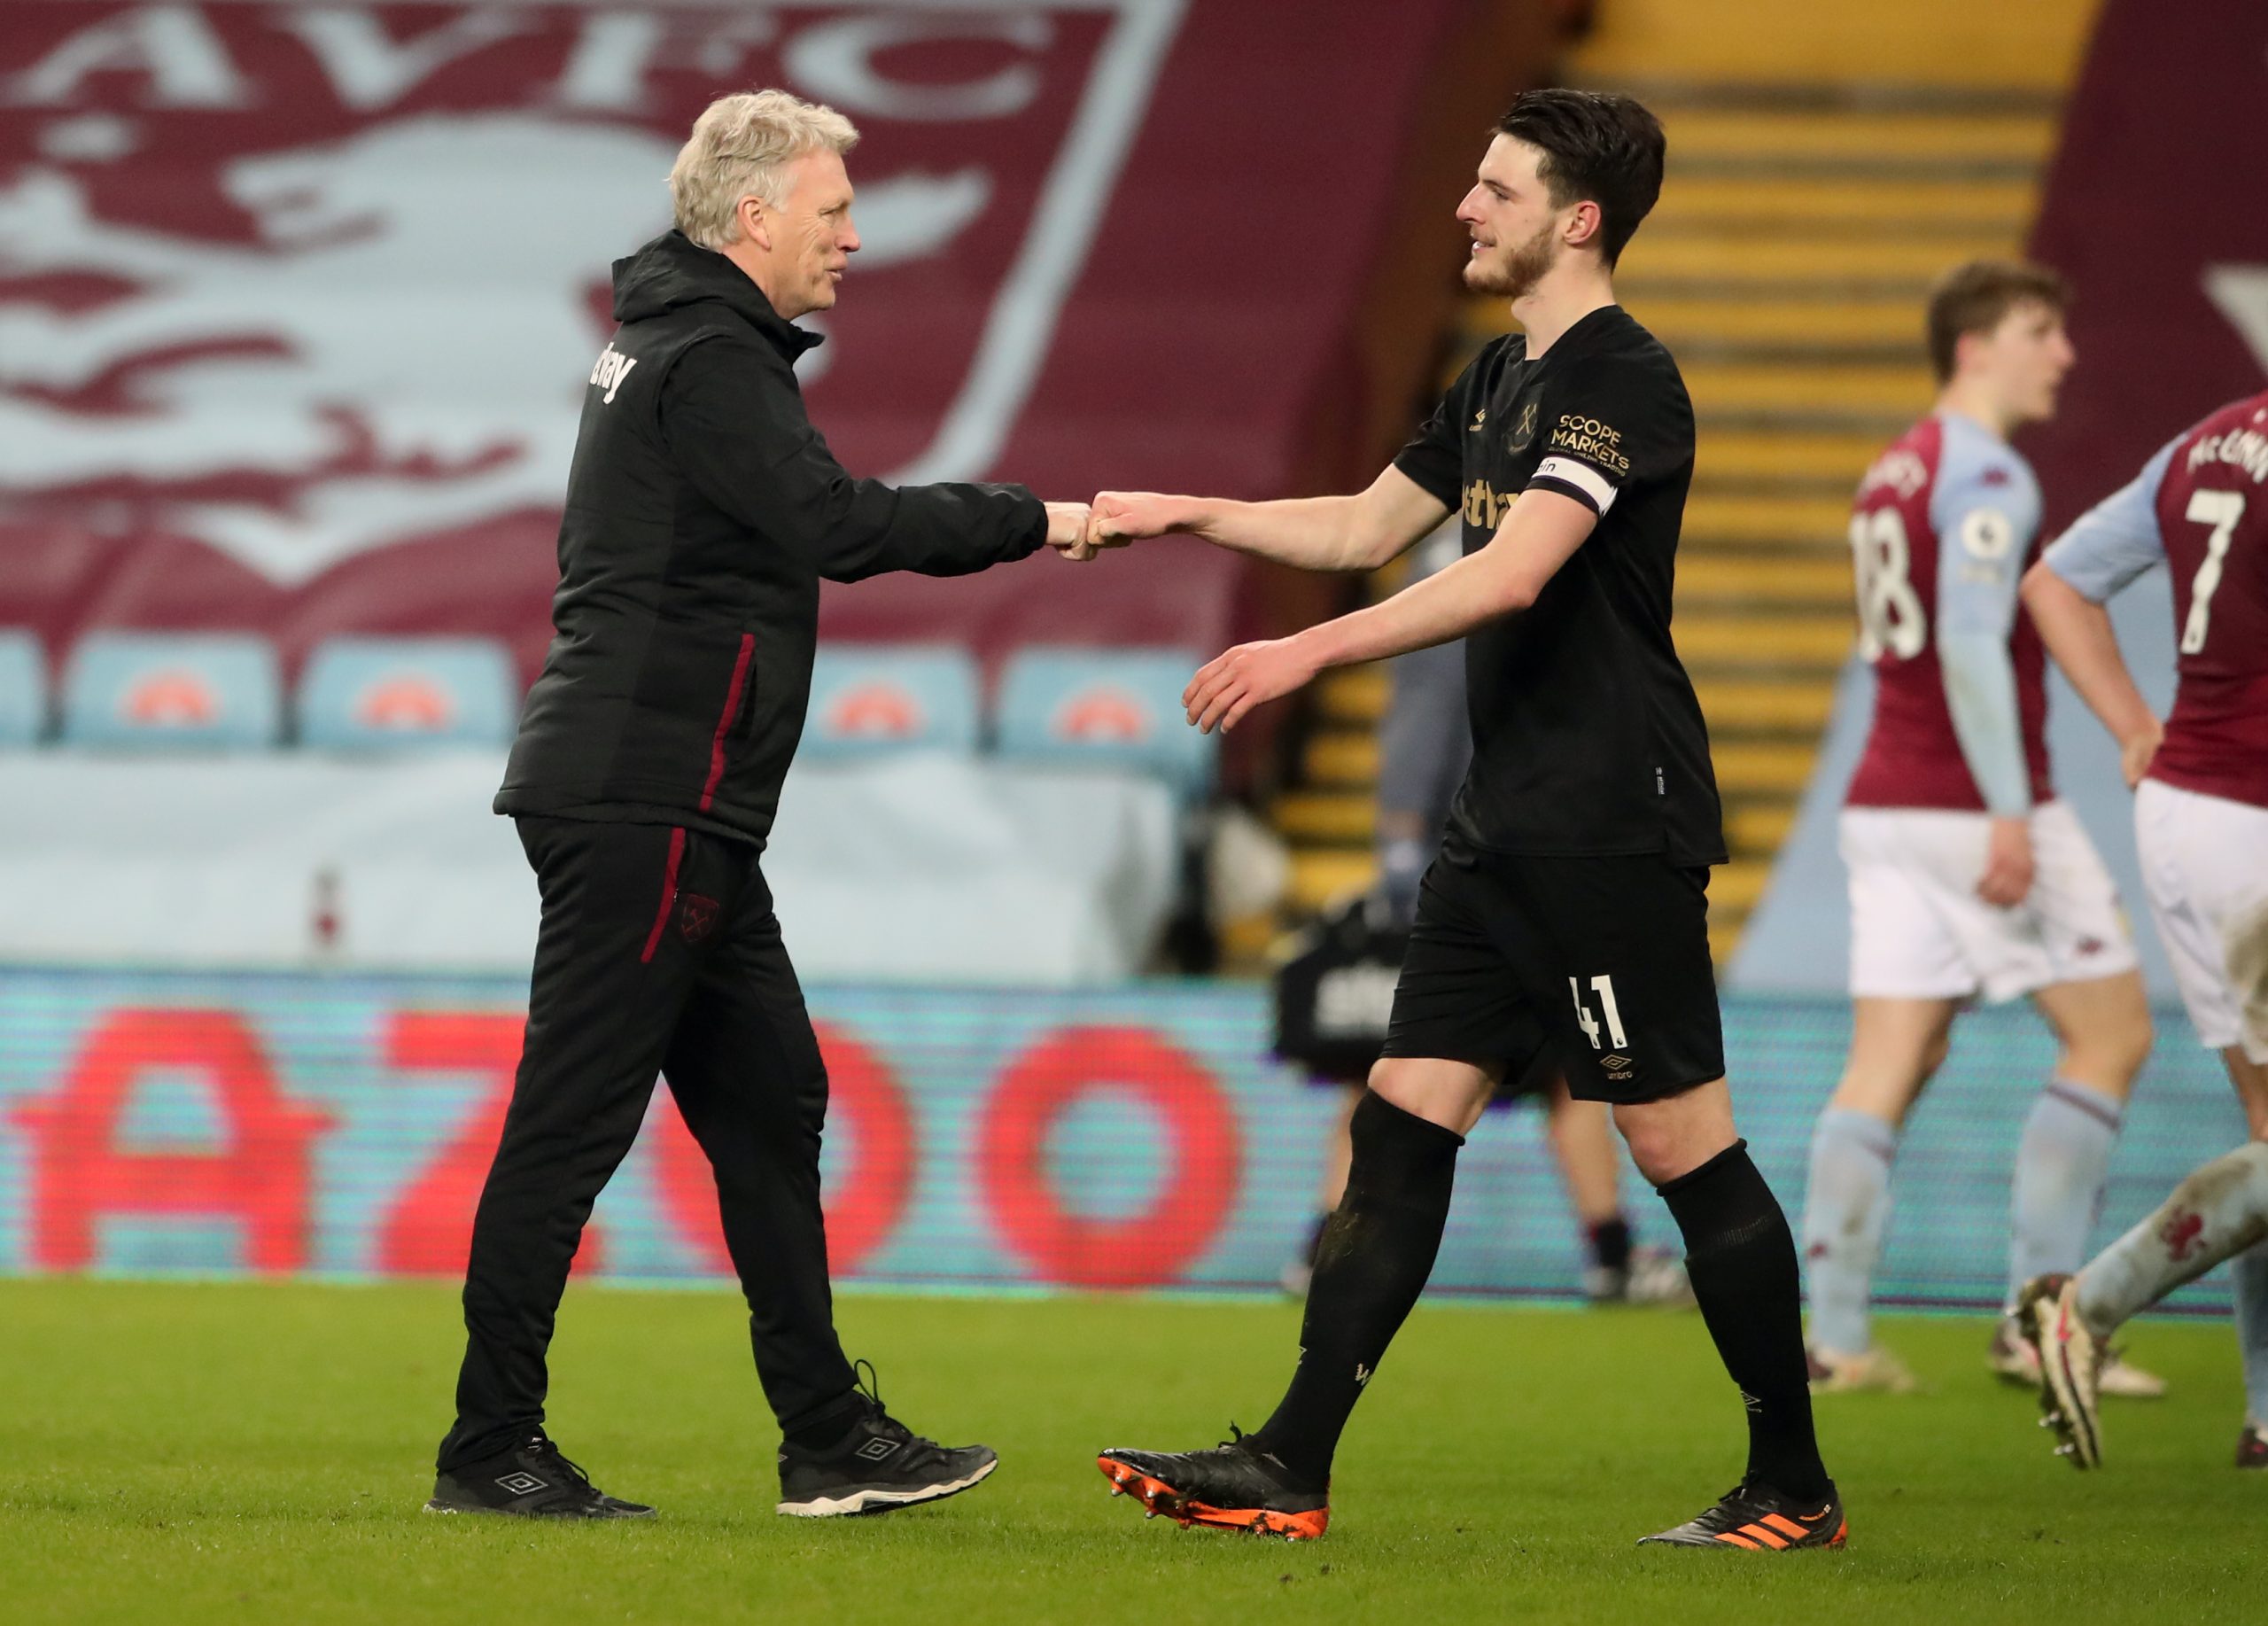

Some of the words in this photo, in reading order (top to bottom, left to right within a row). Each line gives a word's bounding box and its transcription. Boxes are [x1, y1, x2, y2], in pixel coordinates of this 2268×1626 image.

[2, 0, 1056, 121] AVFC
[1550, 429, 1629, 470] MARKETS
[1559, 415, 1621, 447] SCOPE
[1849, 507, 1926, 662] 18
[2180, 489, 2246, 654] 7
[1568, 975, 1628, 1049] 41
